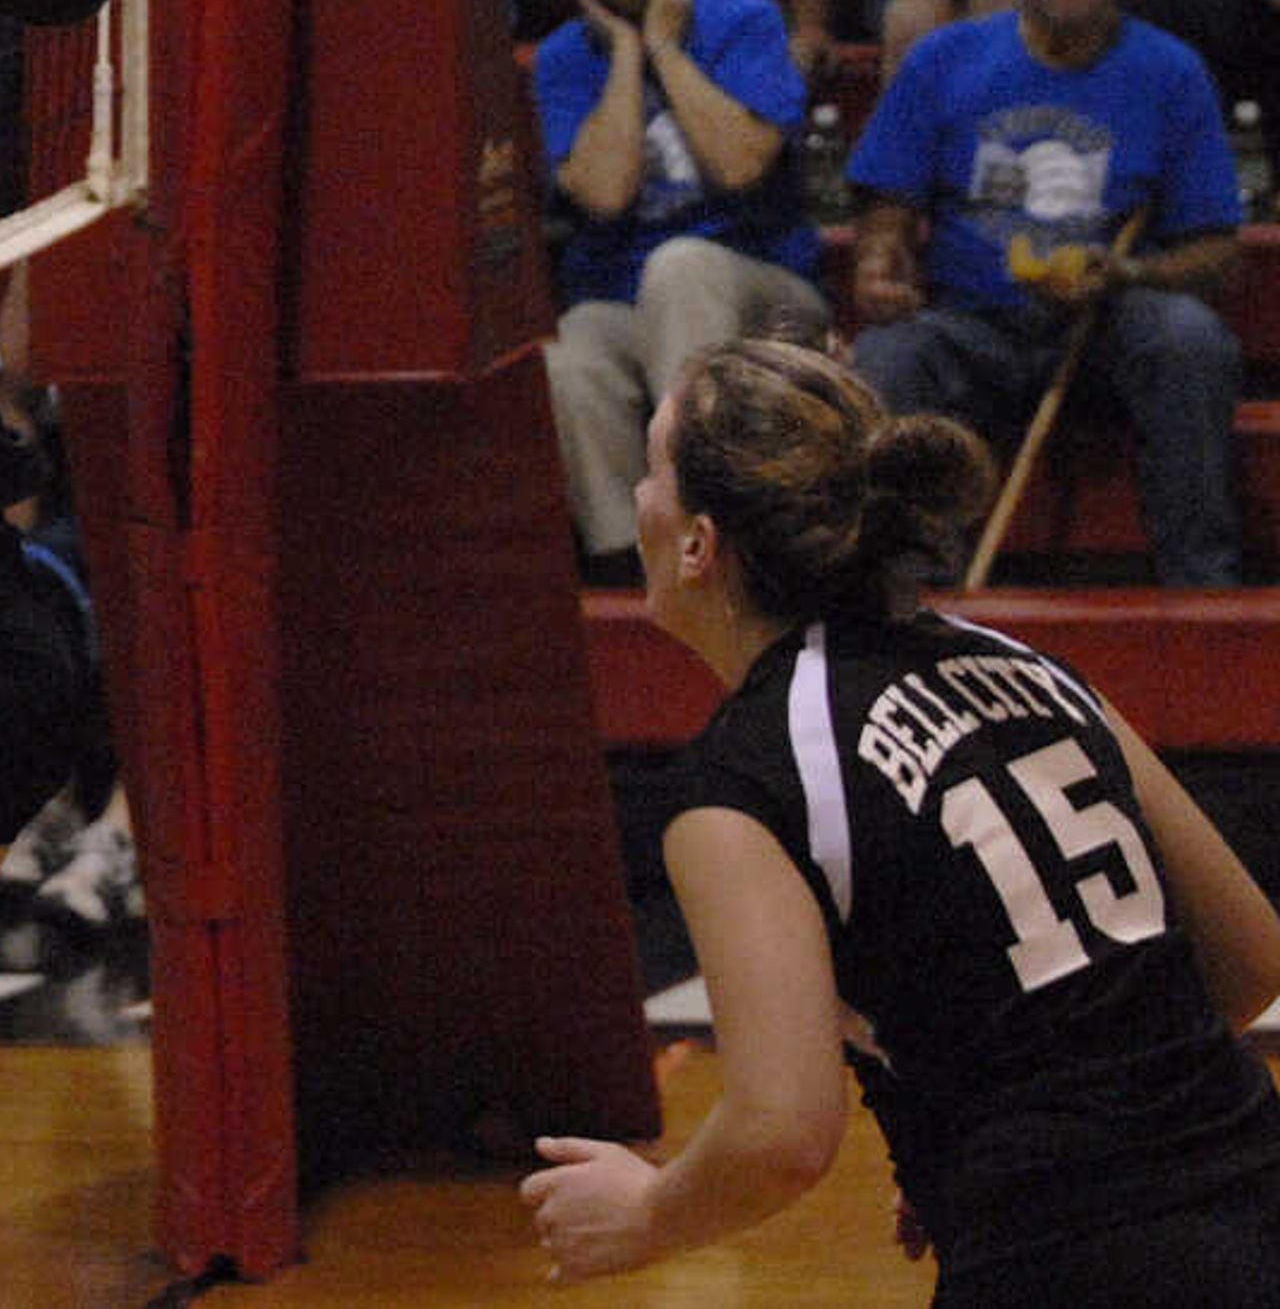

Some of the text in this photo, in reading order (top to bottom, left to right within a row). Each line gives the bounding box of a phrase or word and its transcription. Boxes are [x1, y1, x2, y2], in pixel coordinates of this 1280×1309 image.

[857, 655, 1089, 815] BELL CITY
[940, 737, 1166, 992] 15
